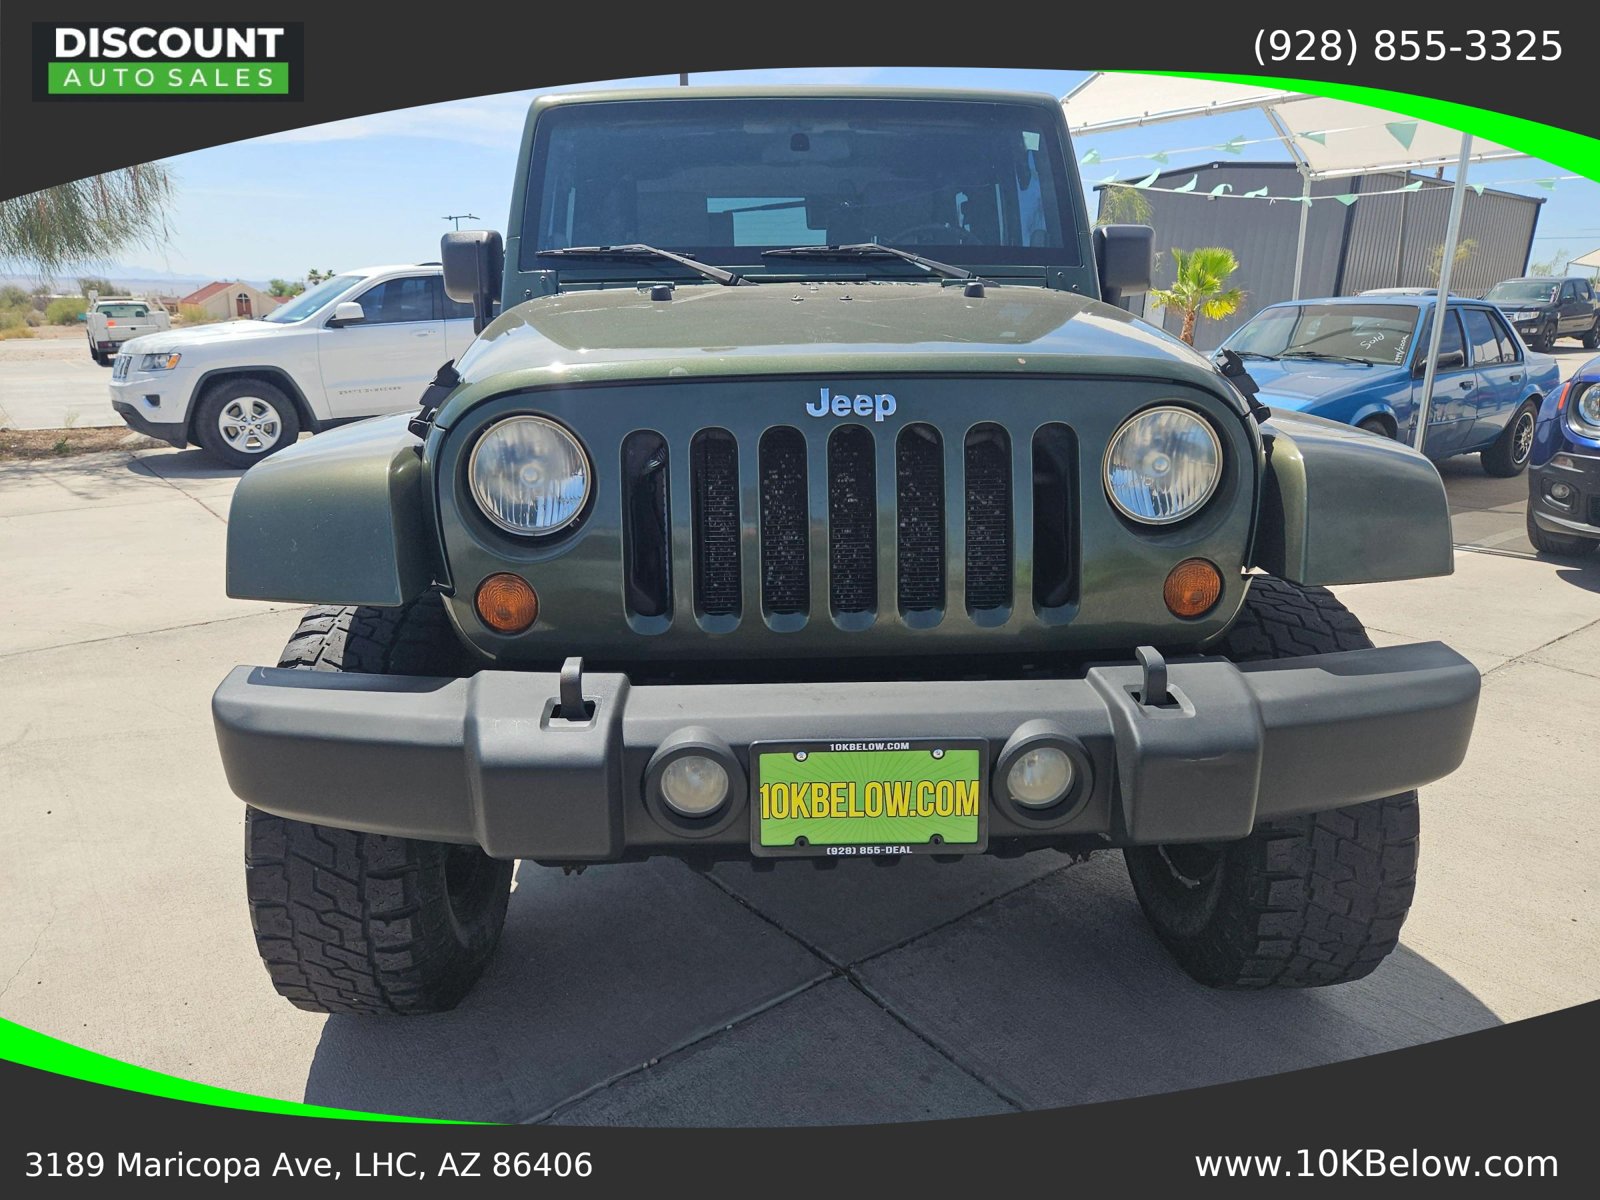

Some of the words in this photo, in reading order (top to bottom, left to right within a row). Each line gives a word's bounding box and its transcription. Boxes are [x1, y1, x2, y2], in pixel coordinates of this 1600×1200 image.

[1360, 332, 1385, 350] Sold
[806, 387, 897, 422] Jeep
[830, 742, 910, 751] 10KBELOW.COM
[760, 780, 980, 819] 10KBELOW.COM
[826, 846, 857, 855] (928)
[859, 845, 913, 855] 855-DEAL
